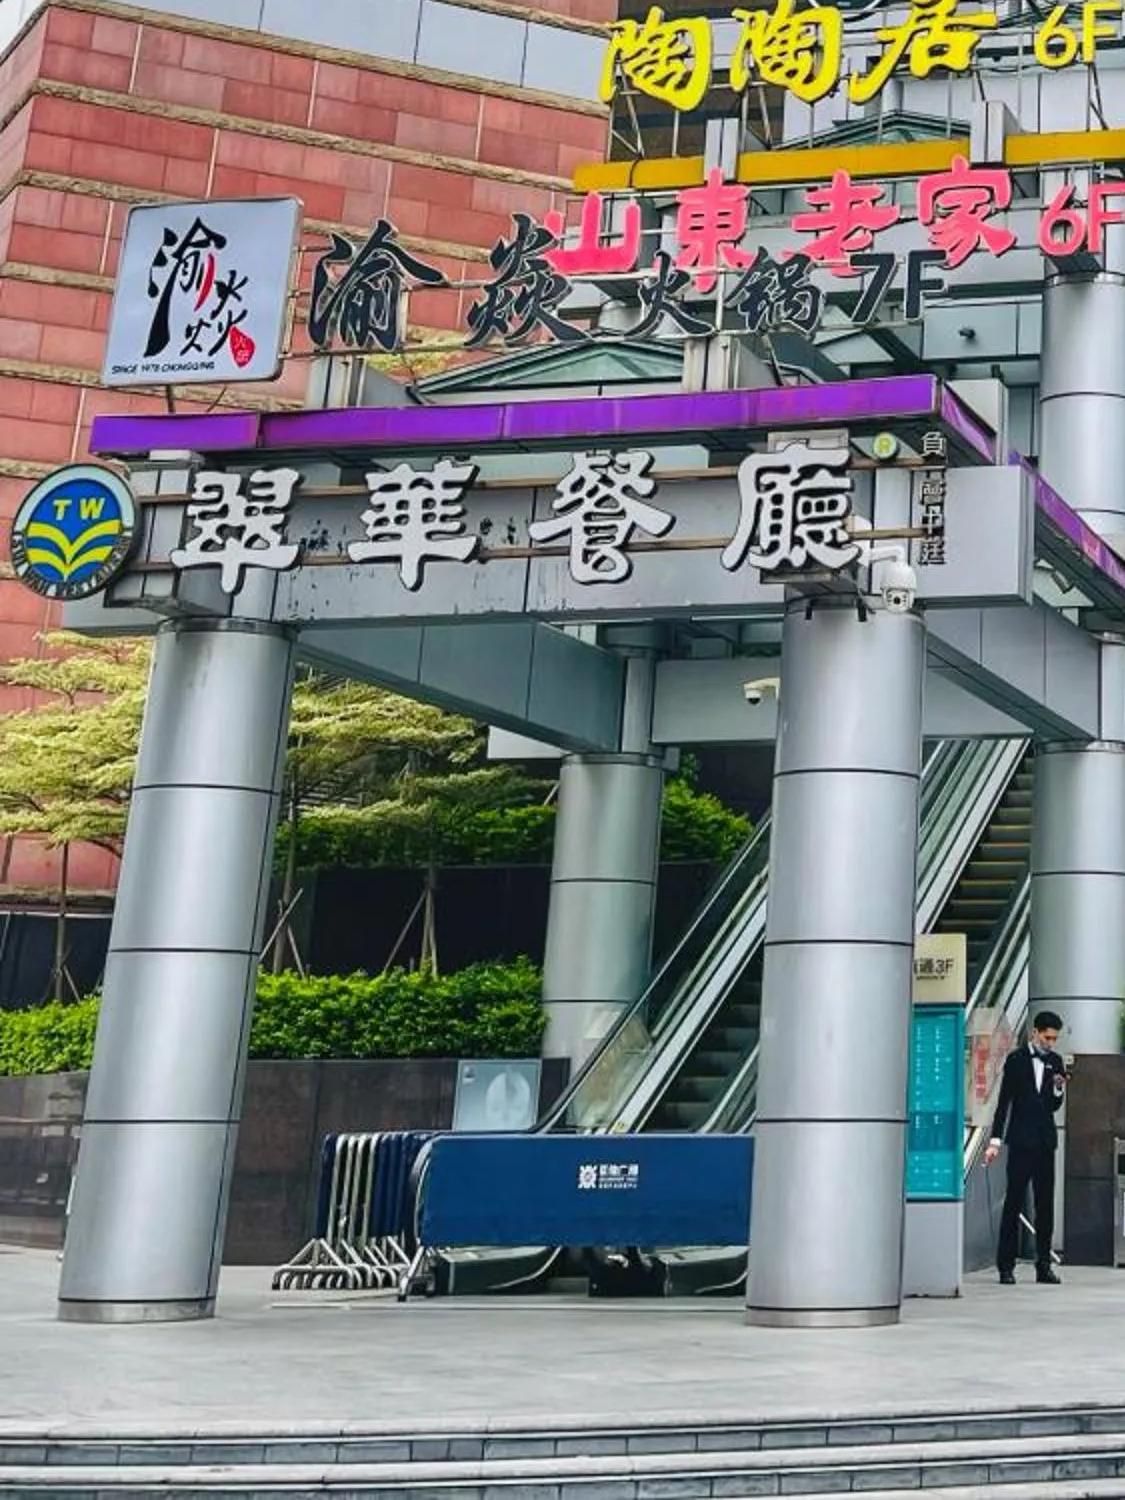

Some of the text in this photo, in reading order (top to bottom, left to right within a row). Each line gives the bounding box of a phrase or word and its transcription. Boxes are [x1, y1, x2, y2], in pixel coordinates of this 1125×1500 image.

[541, 155, 1017, 293] 山東老家
[850, 250, 946, 326] 7F
[170, 440, 862, 594] 翠華餐廳
